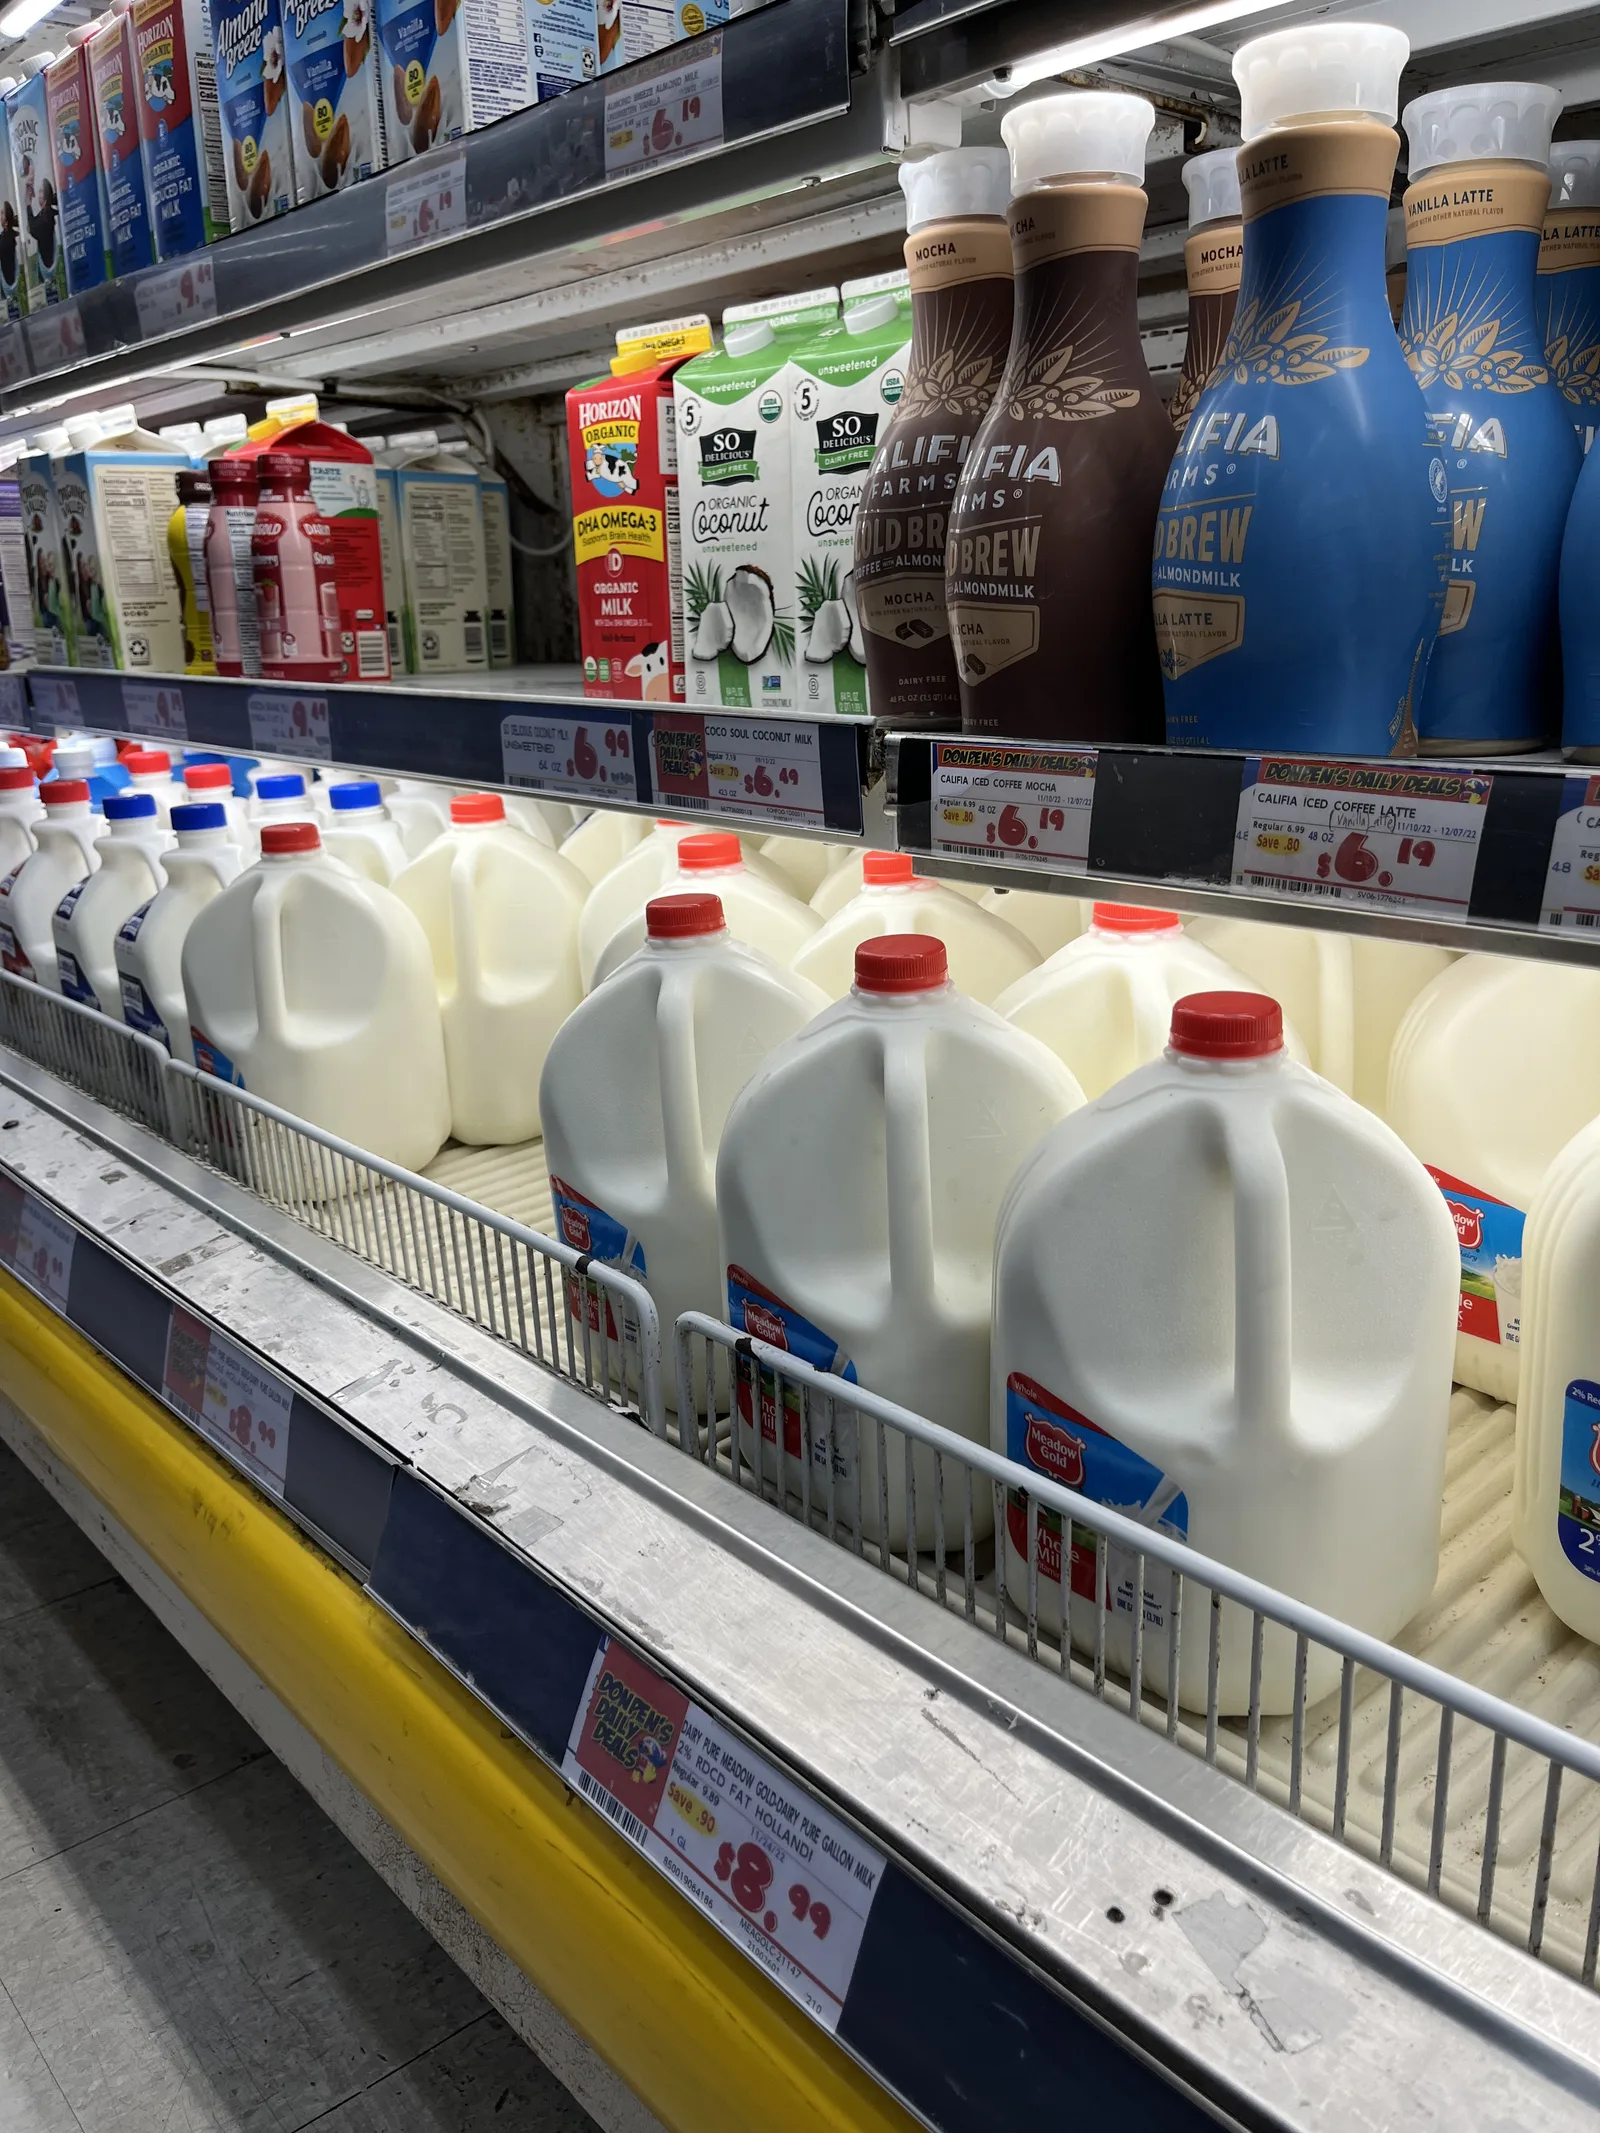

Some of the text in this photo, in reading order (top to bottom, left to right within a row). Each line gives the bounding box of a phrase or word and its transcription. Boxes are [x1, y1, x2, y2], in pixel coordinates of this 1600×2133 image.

[138, 14, 174, 57] HORIZON
[226, 24, 262, 80] Breeze
[409, 68, 418, 82] 80
[684, 70, 699, 82] MILK
[1252, 154, 1289, 178] LATTE
[1408, 189, 1494, 218] VANILLA LATTE
[1433, 207, 1504, 222] OTHER NATURAL FLAVOR
[916, 242, 956, 262] MOCHA
[1201, 244, 1244, 265] MOCHA
[1216, 262, 1241, 272] NATURAL
[818, 356, 878, 376] unsweetened
[700, 378, 757, 395] unsweetened
[886, 377, 900, 386] USDA
[802, 387, 811, 410] 5
[578, 394, 642, 430] HORIZON
[686, 406, 694, 426] 5
[586, 426, 636, 443] ORGANIC
[832, 416, 862, 438] SO
[713, 432, 740, 452] SO
[823, 435, 872, 449] DELICIOUS
[705, 450, 752, 462] DELICIOUS
[824, 450, 869, 466] DAIRY FREE
[706, 463, 748, 478] DAIRY FREE
[870, 472, 956, 500] FARMS
[708, 495, 758, 510] ORGANIC
[578, 511, 656, 538] DHA OMEGA-3
[692, 498, 770, 544] Coconut
[582, 532, 652, 547] Supports Brain Health
[1168, 506, 1254, 564] BREW
[702, 542, 758, 553] unsweetened
[961, 526, 1042, 578] BREW
[856, 559, 882, 580] COFFEE
[1157, 566, 1240, 588] ALMONDMILK
[594, 582, 639, 595] ORGANIC
[954, 581, 1034, 598] ALMONDMILK
[601, 598, 633, 616] MILK
[884, 592, 934, 606] MOCHA
[1171, 612, 1214, 626] LATTE
[984, 638, 1010, 646] FLAVOR
[898, 676, 924, 686] DAIRY
[908, 694, 918, 702] OZ
[980, 718, 999, 726] FREE
[1180, 716, 1198, 724] FREE
[656, 730, 702, 750] DONPEN'S
[704, 726, 813, 745] COCO SOUL COCONUT MILK
[504, 740, 556, 754] UNSWEETENED
[566, 726, 630, 782] $6.99
[659, 746, 688, 762] DAILY
[707, 752, 723, 761] Regular
[943, 749, 1080, 771] DONPEN'S DAILY DEALS
[551, 762, 562, 772] OZ
[662, 760, 690, 776] DEALS
[709, 764, 739, 778] Save .70
[744, 765, 799, 798] $6.49
[940, 774, 1057, 792] CALIFIA ICED COFFEE MOCHA
[1264, 762, 1462, 796] DONPEN'S DAILY DEALS
[728, 789, 737, 798] OZ
[940, 798, 961, 807] Regular
[1037, 794, 1092, 806] 11/10/22 12/07/22
[987, 806, 996, 814] OZ
[1258, 792, 1416, 819] CALIFIA ICED COFFEE LATTE
[944, 809, 974, 822] Save .80
[986, 804, 1066, 849] $6.19
[1252, 820, 1305, 835] Regular 6.99
[1398, 821, 1477, 839] 11/10/22 12/07/22
[1256, 834, 1300, 852] Save .80
[1308, 831, 1335, 843] 48 OZ
[1317, 832, 1436, 888] $6.19
[1552, 861, 1571, 874] 48
[563, 1213, 586, 1232] Meadow
[568, 1225, 583, 1240] Gold
[748, 1310, 782, 1335] Meadow
[756, 1324, 776, 1342] Gold
[1015, 1380, 1038, 1400] Whole
[1572, 1386, 1586, 1400] 2%
[1032, 1426, 1077, 1460] Meadow
[1040, 1445, 1067, 1470] Gold
[597, 1670, 675, 1745] DONPEN'S
[594, 1697, 639, 1742] DAILY
[592, 1718, 640, 1770] DEALS
[672, 1759, 720, 1807] Regular 9.89
[667, 1780, 716, 1834] Save .90
[677, 1740, 814, 1863] 2% RDCD FAT HOLLANDI
[682, 1719, 876, 1891] DAIRY PURE MEADOW GOLD-DAIRY PURE GALLON MILK
[670, 1828, 687, 1850] 1 GL
[750, 1826, 786, 1864] 11/24/22
[714, 1842, 832, 1941] $8.99
[806, 1994, 822, 2014] 210
